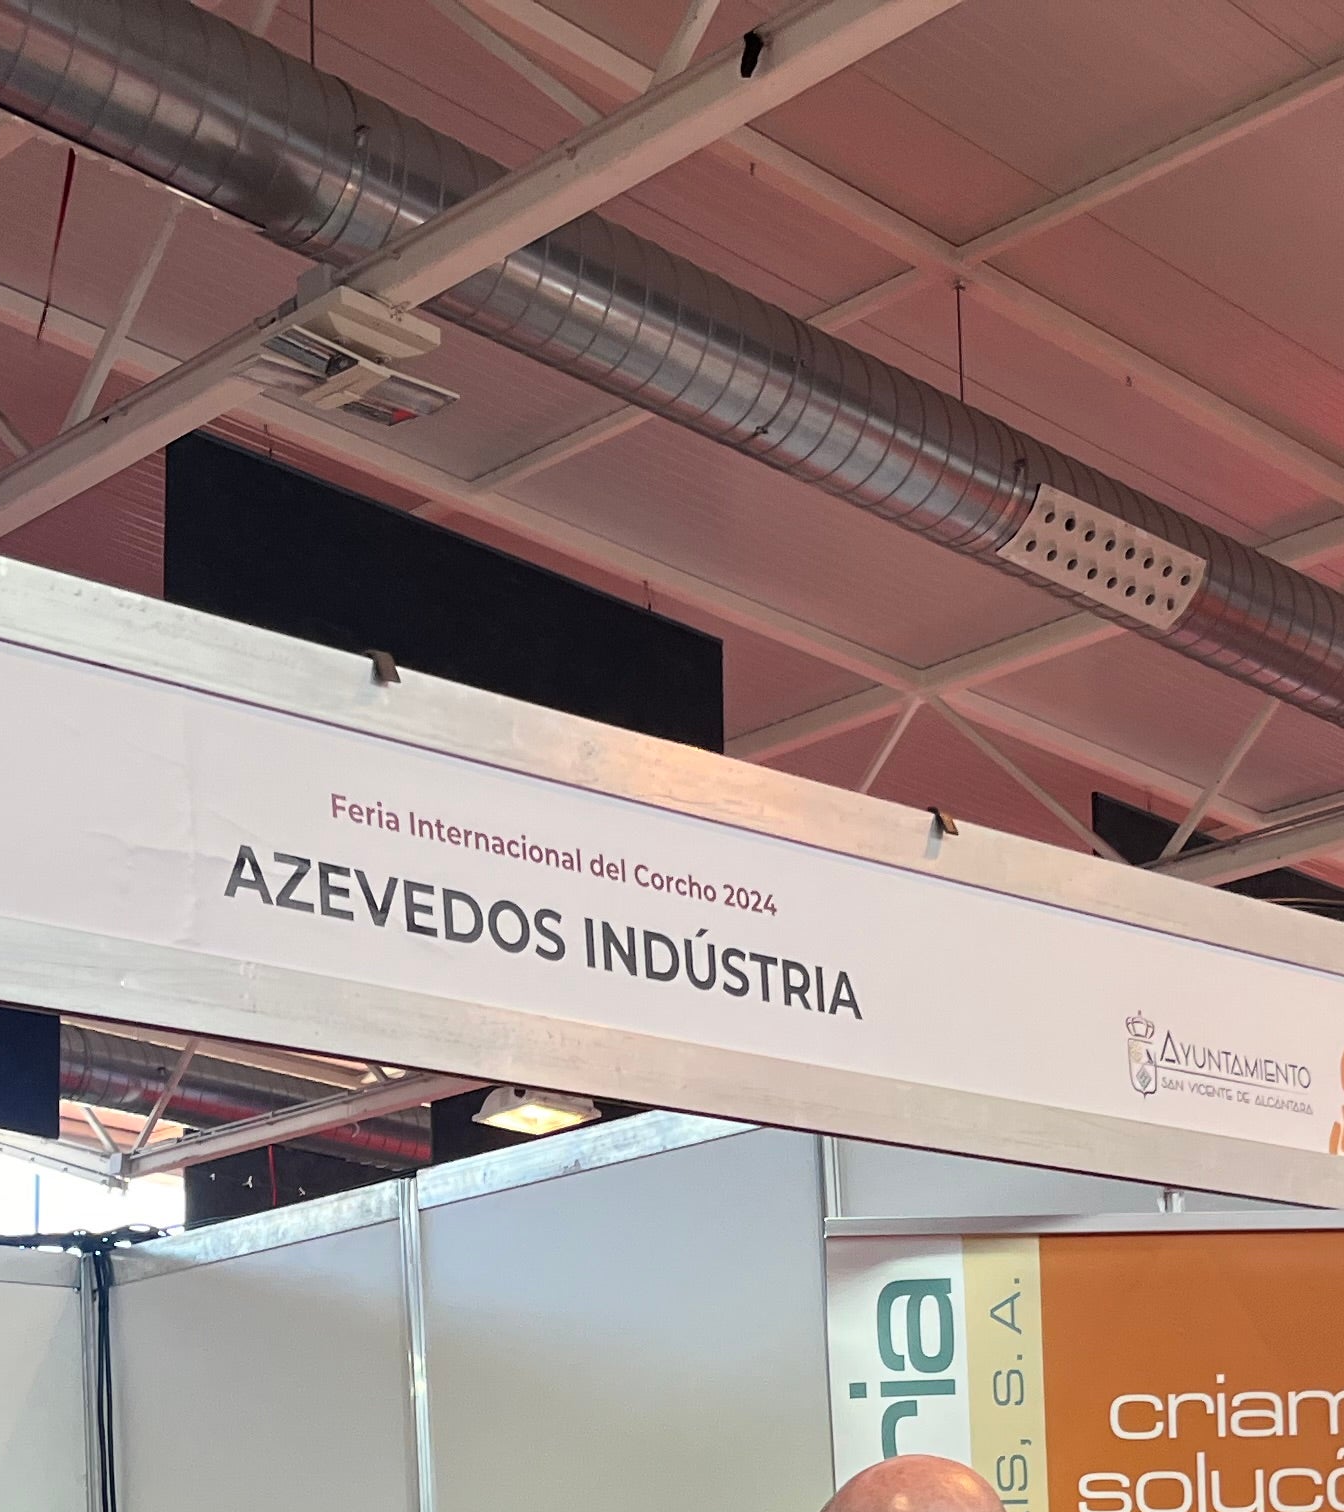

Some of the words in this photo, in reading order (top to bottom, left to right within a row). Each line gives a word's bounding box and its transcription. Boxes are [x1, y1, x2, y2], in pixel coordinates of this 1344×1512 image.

[330, 792, 401, 833] Feria
[409, 810, 582, 873] Internacional
[590, 852, 627, 884] del
[634, 864, 717, 903] Corcho
[723, 883, 779, 917] 2024
[223, 843, 567, 962] AZEVEDOS
[583, 917, 863, 1021] INDÚSTRIA
